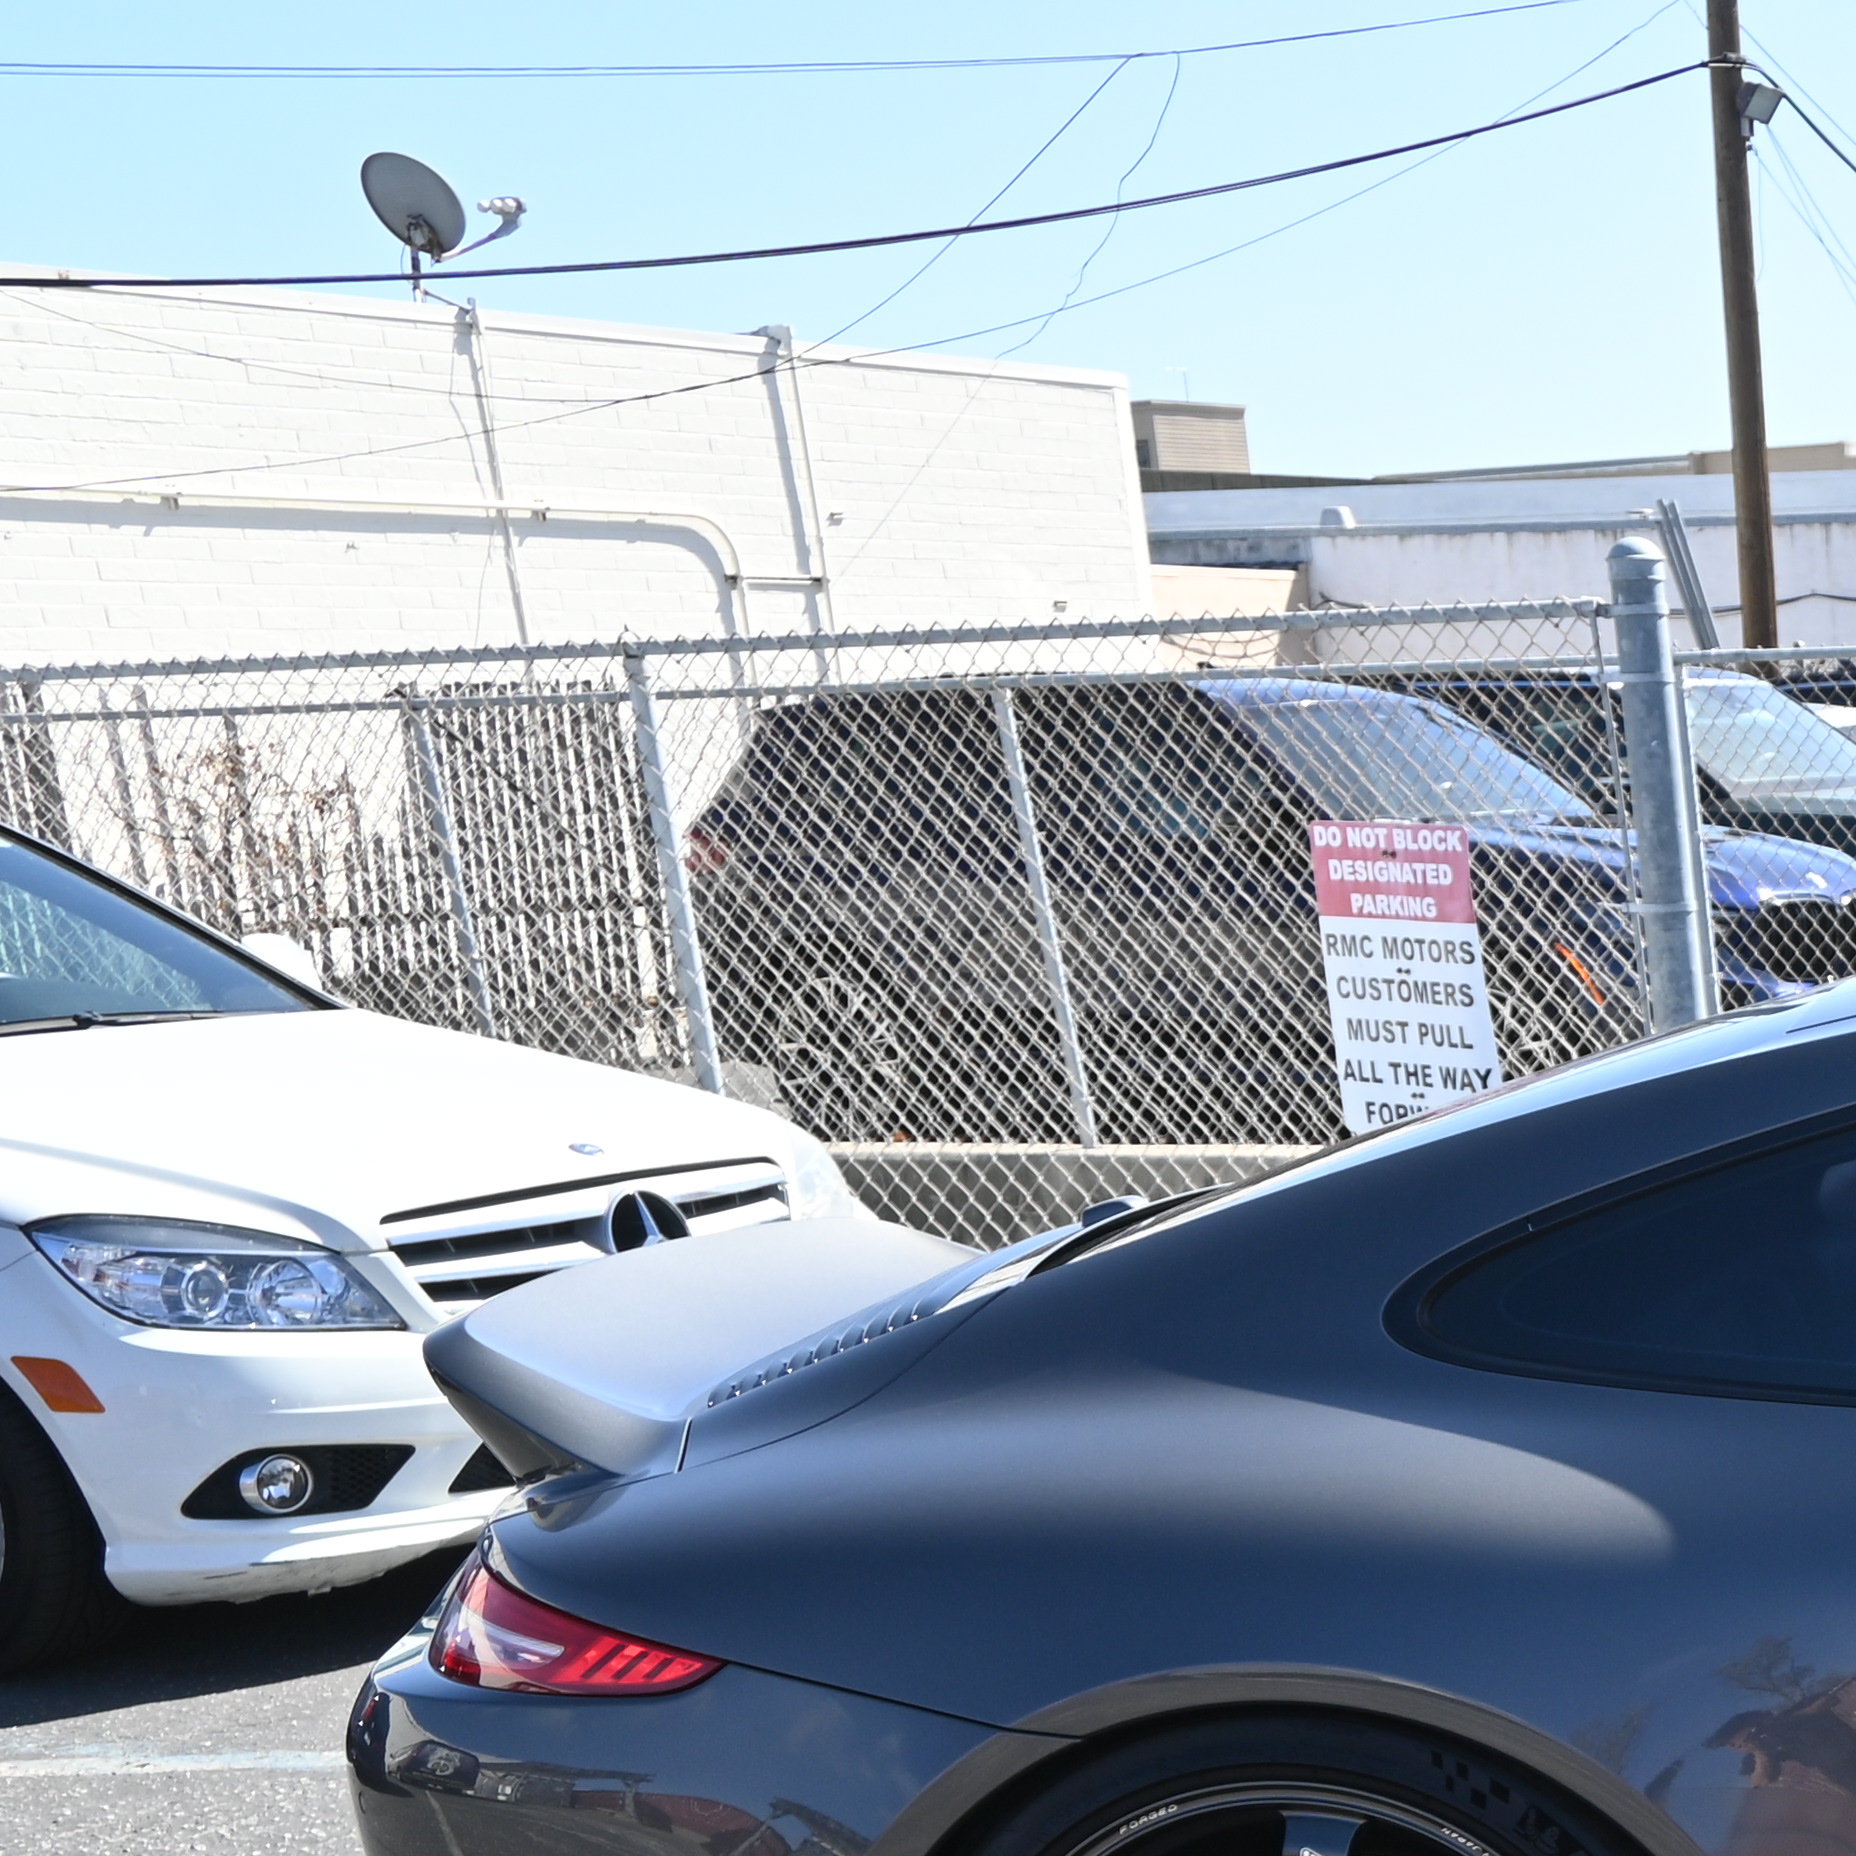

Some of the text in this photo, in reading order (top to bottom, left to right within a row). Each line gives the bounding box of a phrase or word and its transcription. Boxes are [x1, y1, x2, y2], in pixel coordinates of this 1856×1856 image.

[1313, 826, 1462, 851] DO NOT BLOCK
[1328, 859, 1453, 885] DESIGNATED
[1350, 893, 1437, 918] PARKING
[1325, 933, 1476, 965] RMC MOTORS
[1336, 975, 1475, 1008] CUSTOMERS
[1346, 1018, 1474, 1049] MUST PULL
[1343, 1059, 1493, 1094] ALL THE WAY
[1119, 1804, 1178, 1835] FORGED
[1440, 1827, 1481, 1851] JAPAN
